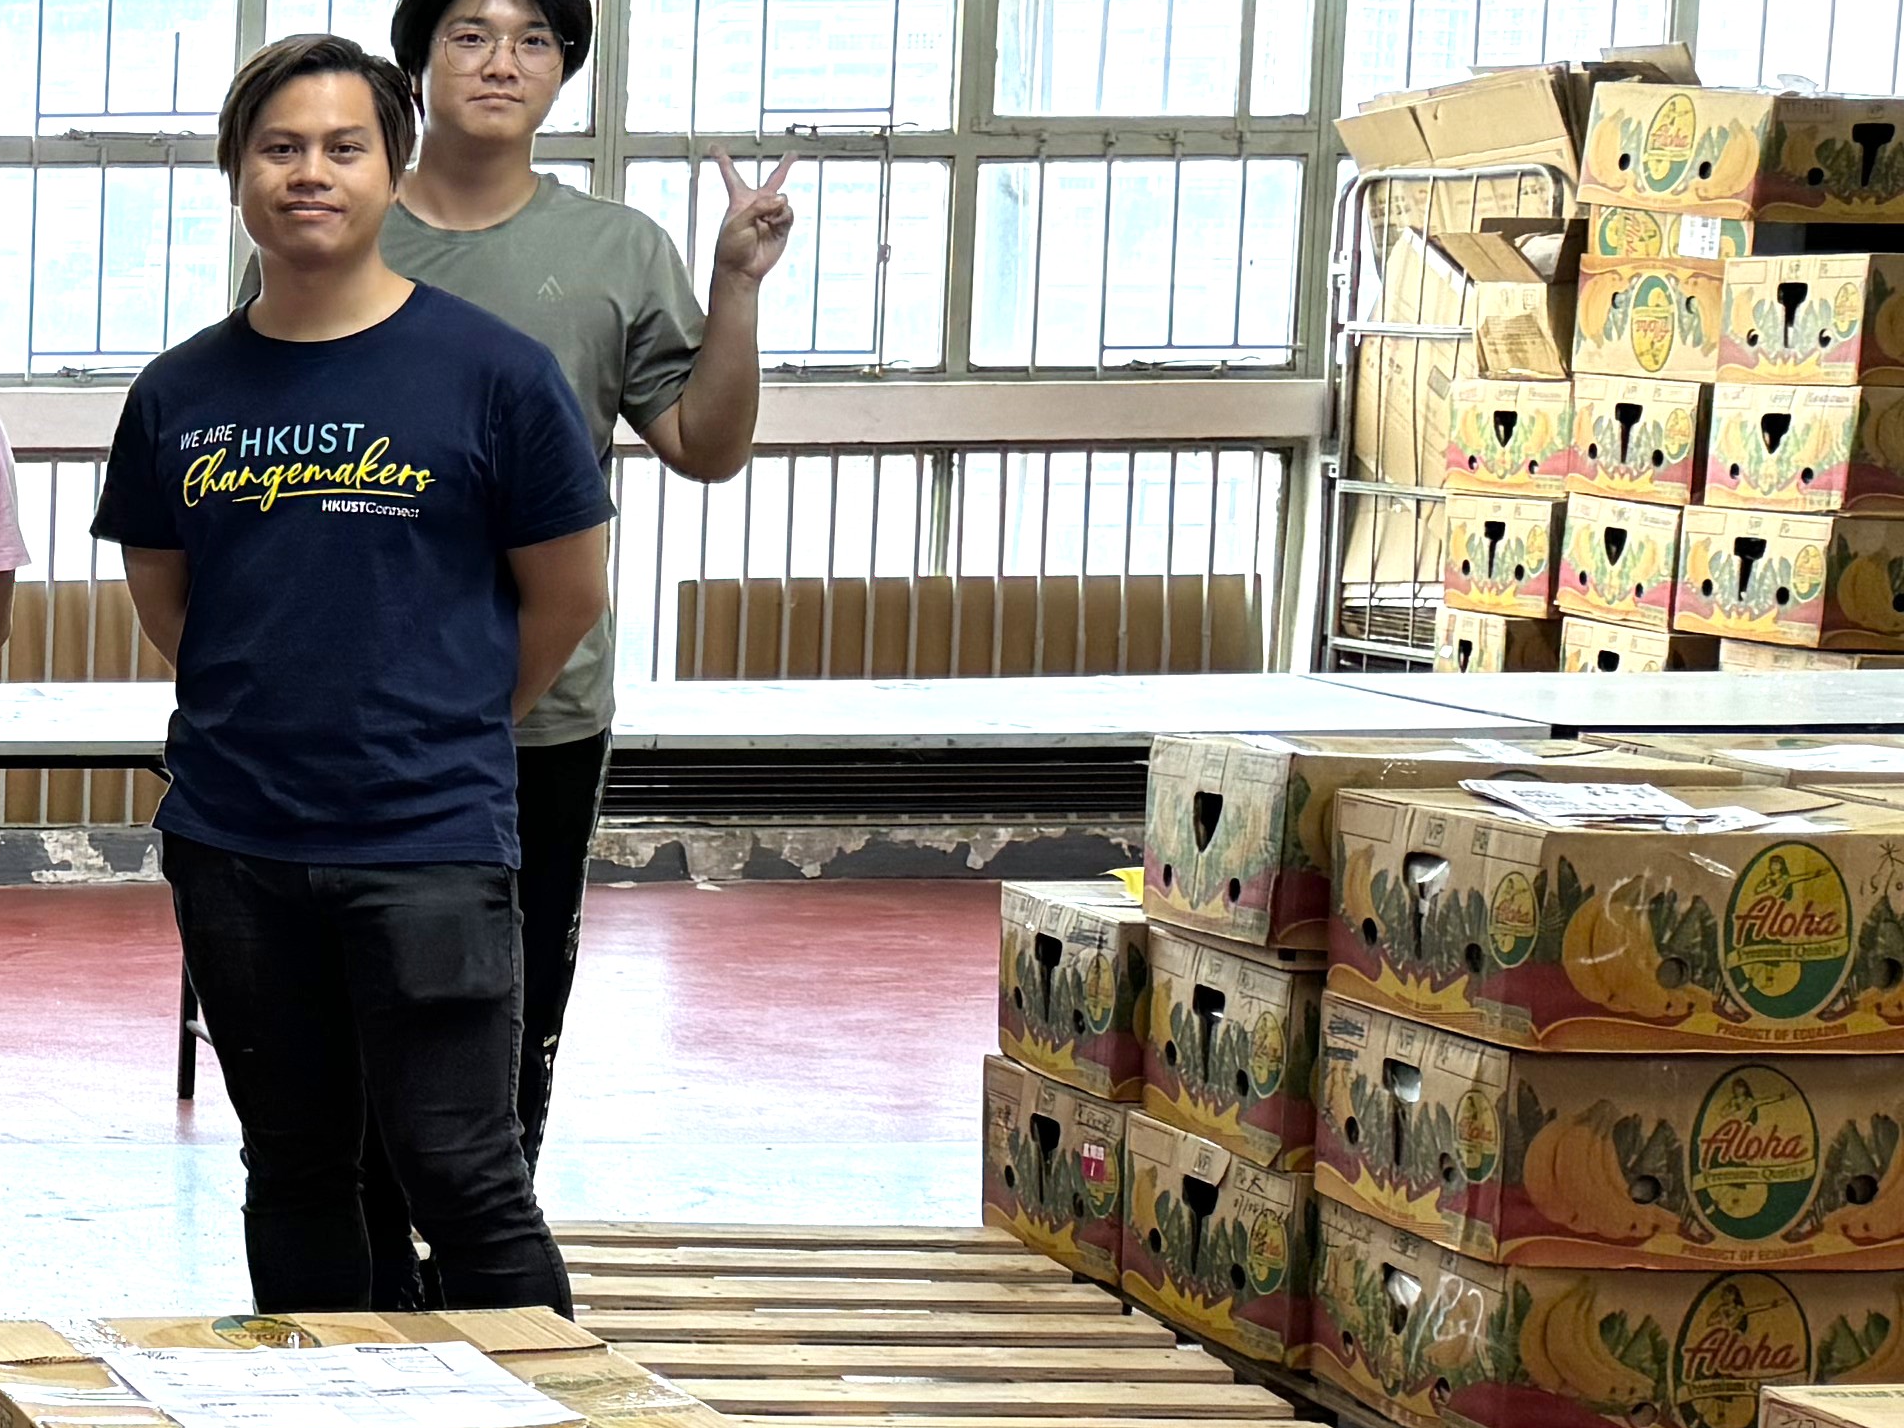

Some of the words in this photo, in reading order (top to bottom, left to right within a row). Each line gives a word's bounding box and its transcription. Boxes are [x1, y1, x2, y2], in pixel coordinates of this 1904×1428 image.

[1651, 128, 1690, 149] Aloha
[180, 429, 199, 451] WE
[203, 423, 236, 445] ARE
[239, 422, 365, 458] HKUST
[183, 436, 436, 512] Changemakers
[321, 499, 420, 518] HKUSTConnect
[1735, 896, 1842, 946] Aloha
[1715, 1023, 1770, 1040] PRODUCT
[1773, 1023, 1789, 1040] OF
[1792, 1023, 1849, 1040] ECUADOR
[1700, 1120, 1809, 1164] Aloha
[1681, 1324, 1800, 1377] Aloha
